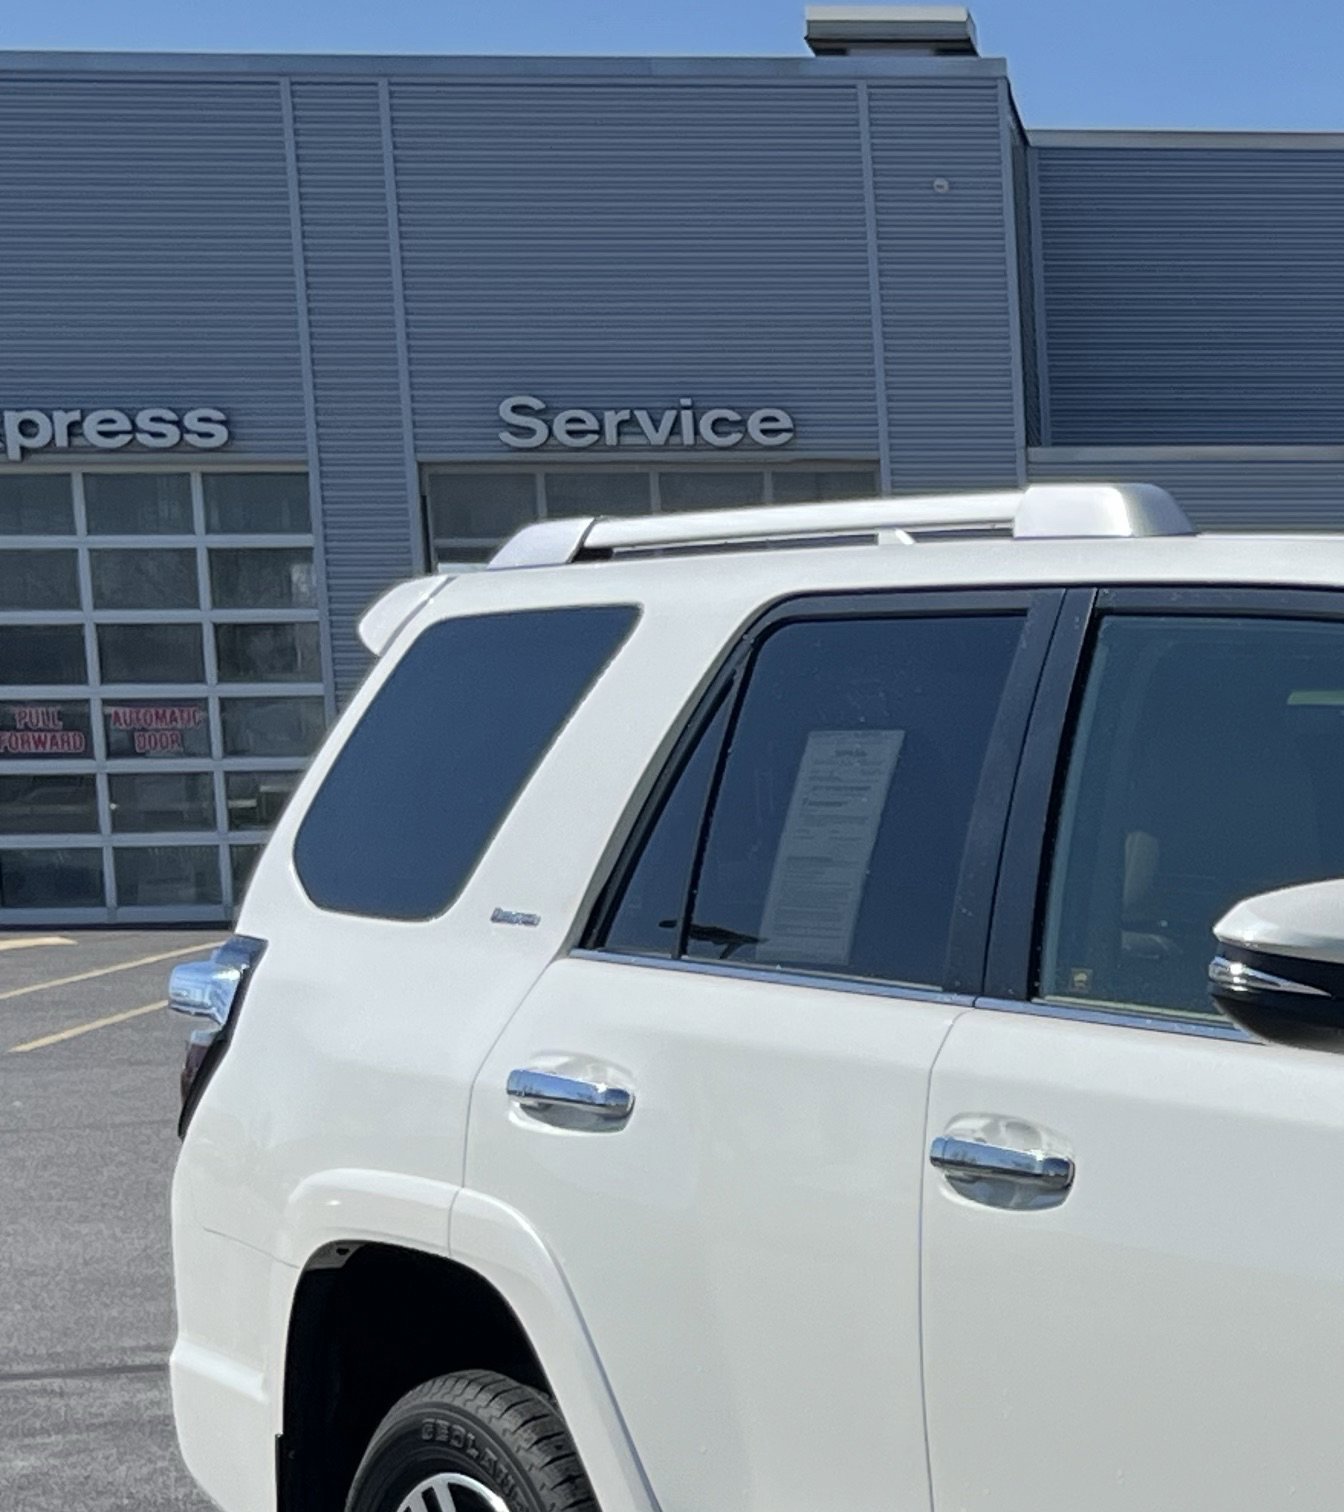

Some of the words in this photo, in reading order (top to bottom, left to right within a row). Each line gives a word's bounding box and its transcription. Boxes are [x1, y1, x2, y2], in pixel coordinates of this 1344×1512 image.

[497, 395, 795, 449] Service
[0, 407, 230, 462] press
[15, 706, 63, 730] PULL
[111, 706, 203, 730] AUTOMATIC
[134, 731, 183, 753] DOOR
